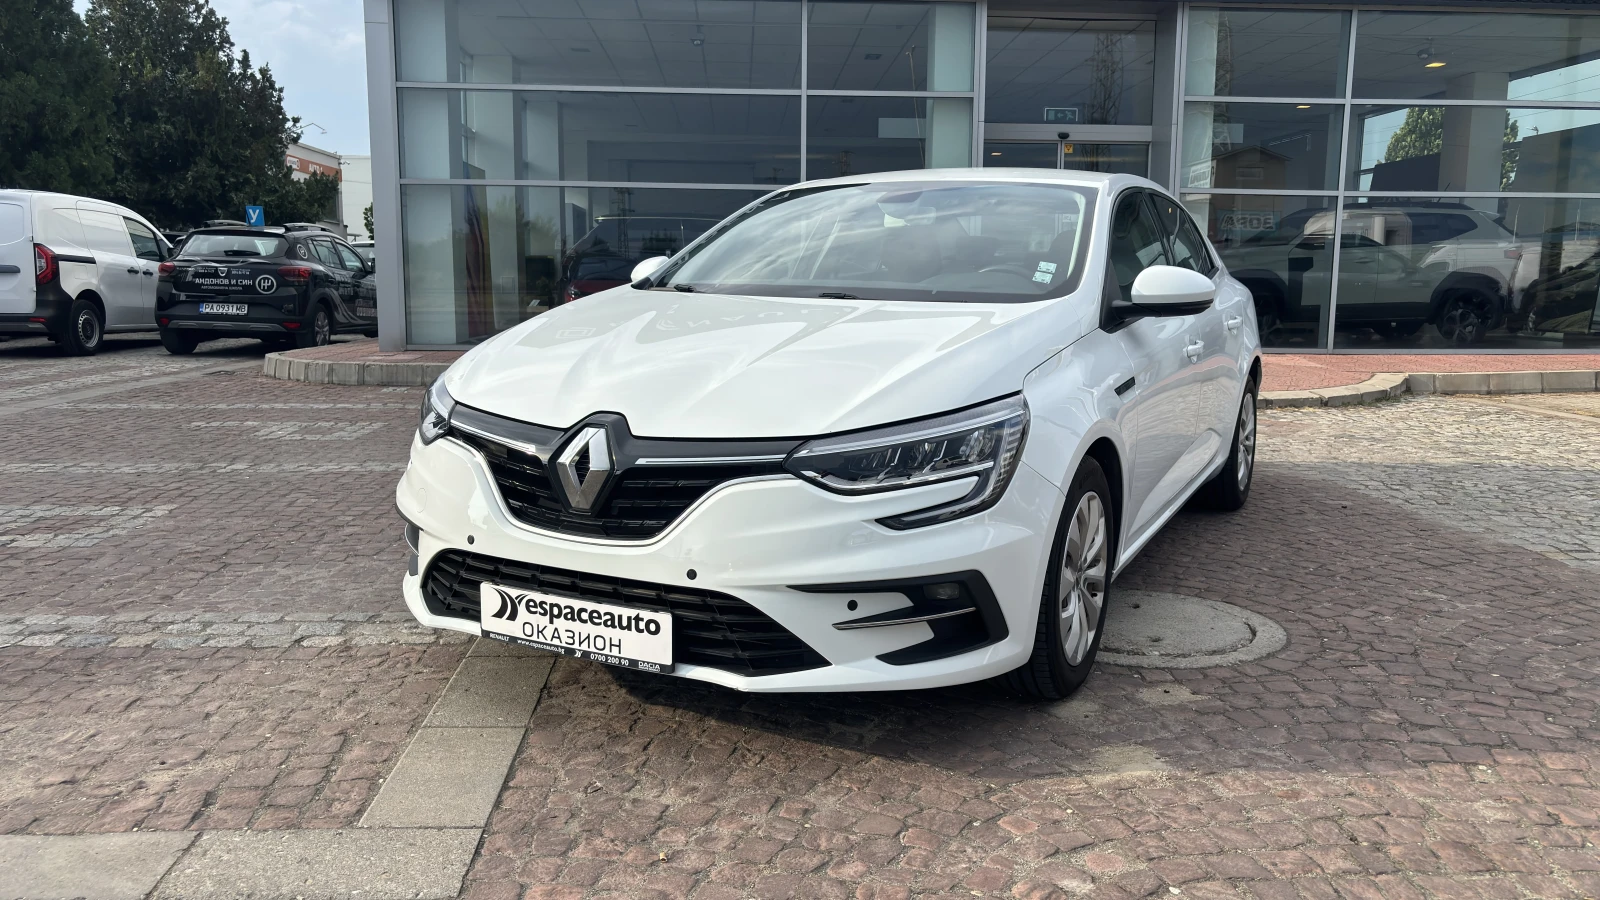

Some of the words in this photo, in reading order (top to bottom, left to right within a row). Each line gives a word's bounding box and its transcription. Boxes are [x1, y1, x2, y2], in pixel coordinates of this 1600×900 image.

[215, 304, 234, 312] 0931
[525, 598, 661, 635] espaceauto
[489, 633, 510, 642] RENAULT
[522, 621, 622, 655] ОКАЗИОН
[516, 638, 565, 655] www.espaceauto.bg
[590, 653, 606, 662] 0700
[607, 656, 620, 665] 200
[638, 661, 660, 669] DACIA
